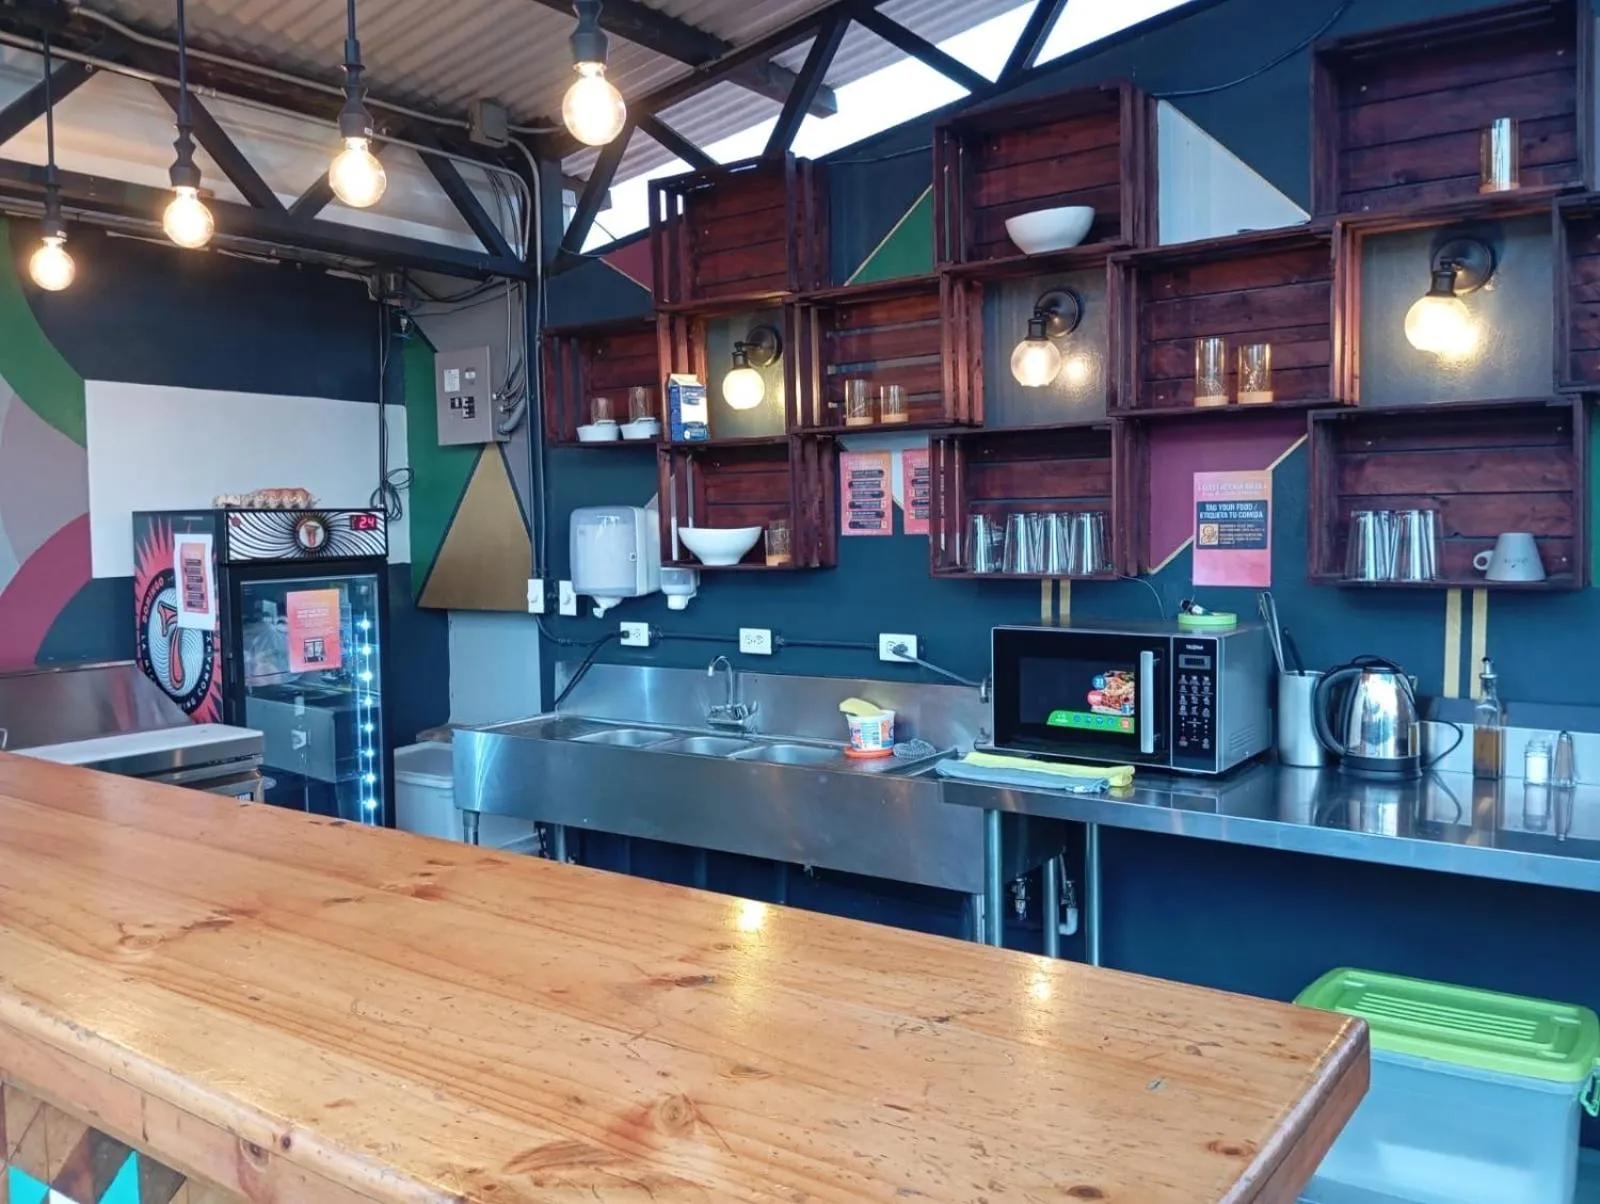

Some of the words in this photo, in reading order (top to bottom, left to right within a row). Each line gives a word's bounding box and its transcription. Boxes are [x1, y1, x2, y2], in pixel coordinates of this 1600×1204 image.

[1219, 503, 1235, 511] YOUR
[1236, 503, 1253, 511] FOOD
[359, 516, 375, 529] 24
